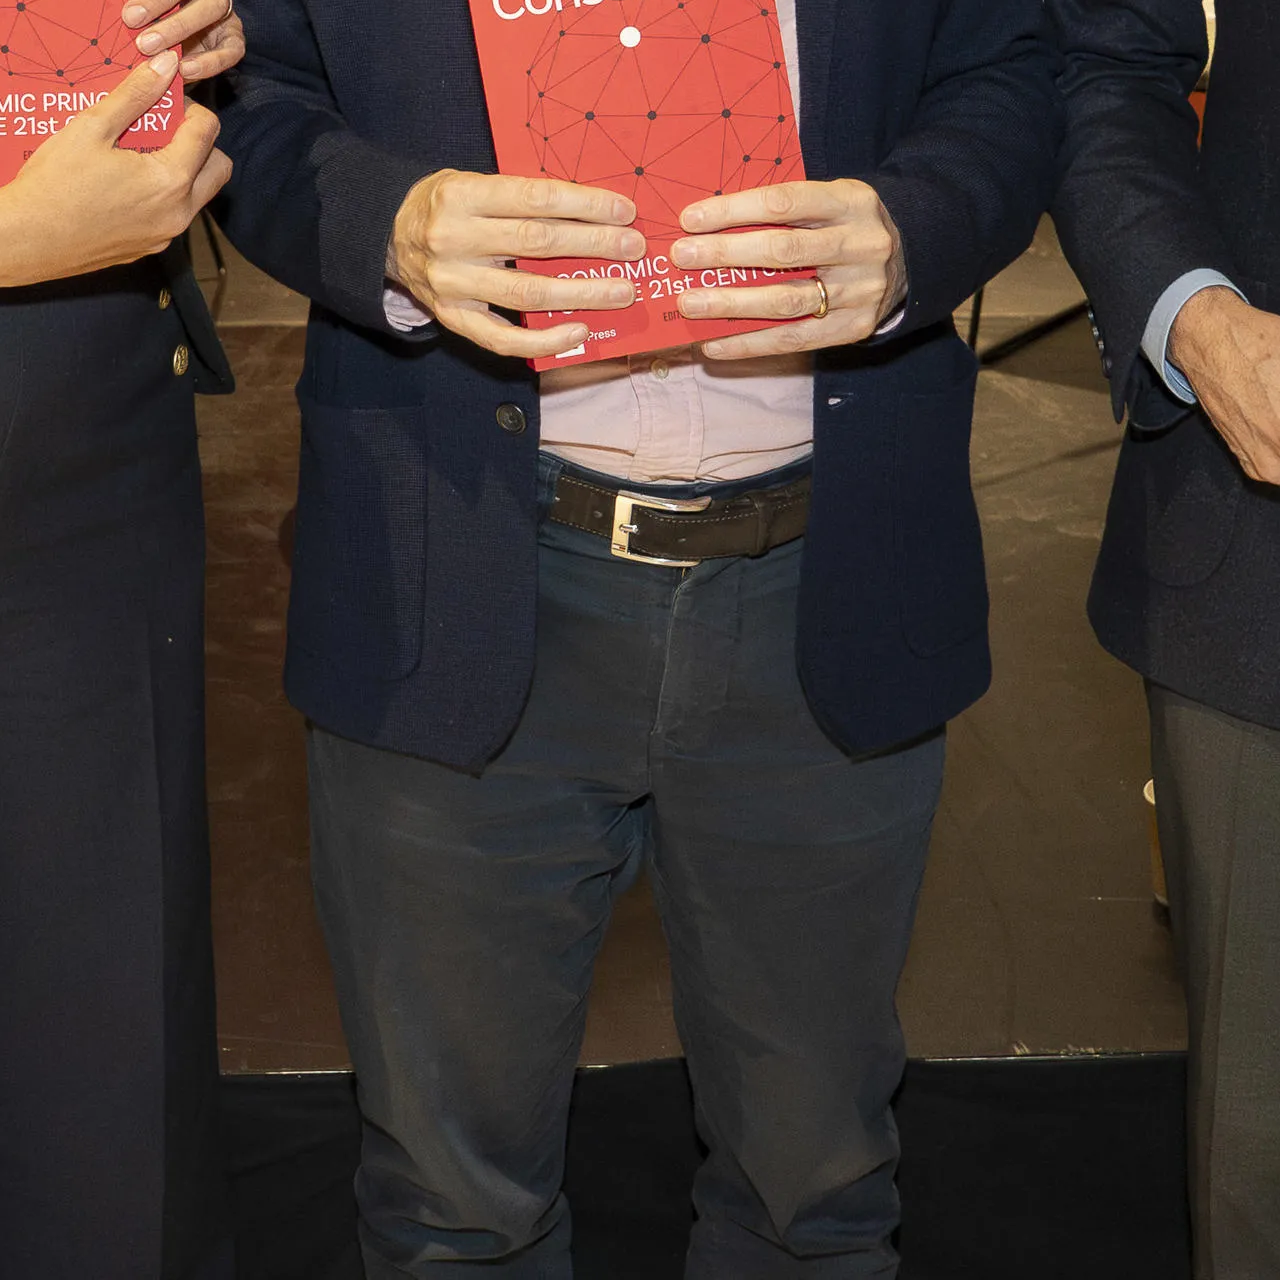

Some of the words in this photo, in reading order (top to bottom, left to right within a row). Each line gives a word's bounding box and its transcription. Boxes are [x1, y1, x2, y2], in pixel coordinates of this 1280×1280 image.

[14, 116, 59, 136] 21st
[649, 277, 694, 299] 21st
[588, 328, 617, 342] Press
